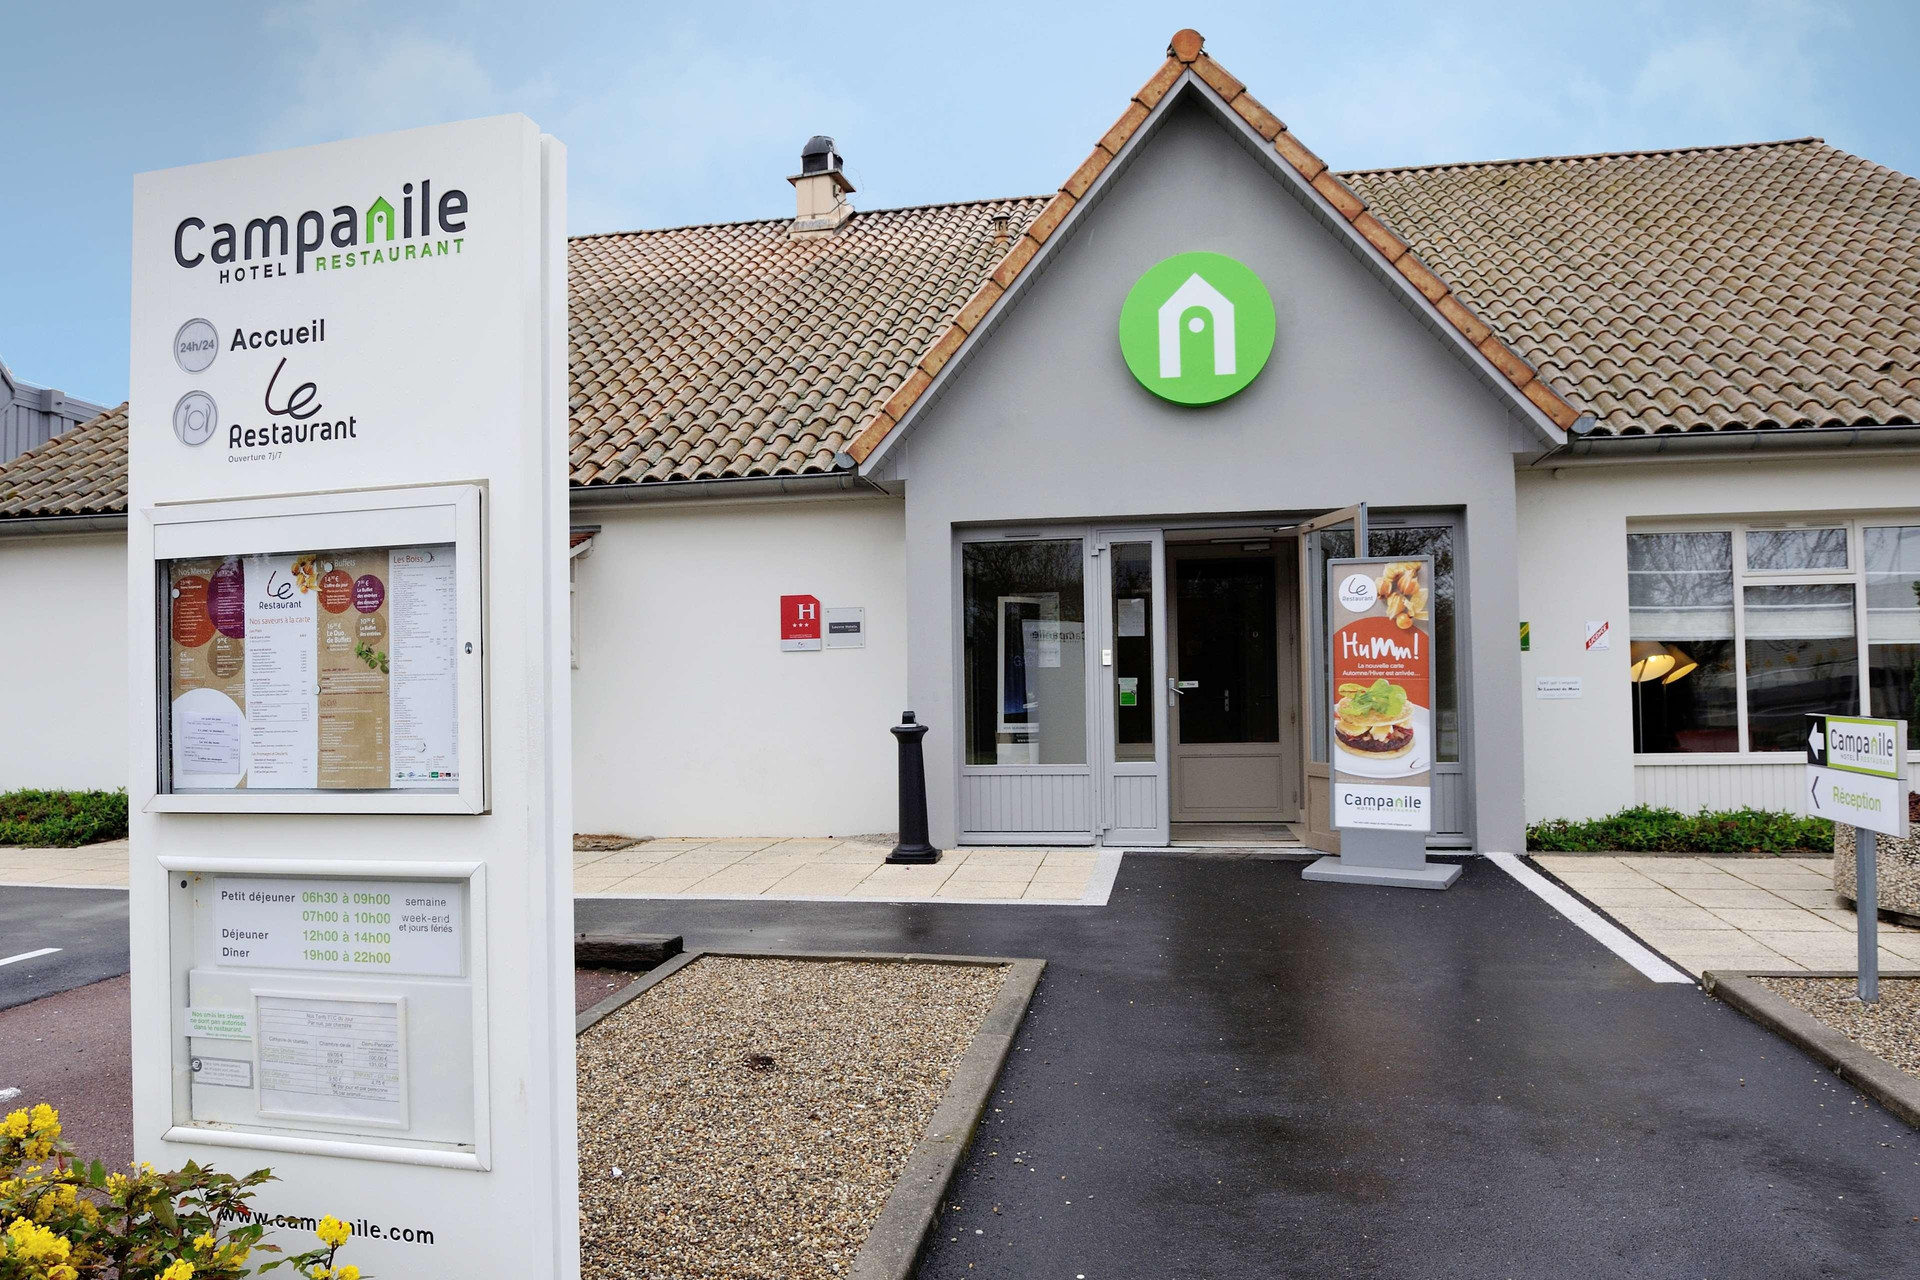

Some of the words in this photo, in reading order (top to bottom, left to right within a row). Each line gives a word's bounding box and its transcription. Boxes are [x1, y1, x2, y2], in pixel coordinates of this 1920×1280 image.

[174, 179, 469, 273] Campanile
[219, 262, 287, 284] HOTEL
[315, 238, 465, 272] RESTAURANT
[230, 319, 326, 352] Accueil
[180, 339, 215, 354] 24h/24
[265, 357, 323, 420] Le
[228, 416, 357, 449] Restaurant
[228, 452, 266, 463] Ouverture
[268, 451, 283, 463] 7j/7
[334, 559, 356, 567] Buffets
[406, 555, 435, 563] Boisss
[266, 571, 294, 600] Le
[1348, 577, 1368, 595] Le
[259, 600, 302, 610] Restaurant
[798, 603, 815, 620] H
[1831, 729, 1893, 761] Campanile
[1344, 793, 1422, 811] Campanile
[1832, 786, 1882, 812] Réception
[221, 890, 246, 902] Petit
[249, 891, 296, 903] déjeuner
[302, 892, 338, 905] 06h30
[343, 892, 349, 904] à
[353, 893, 391, 906] 09h00
[405, 897, 447, 908] semaine
[302, 911, 338, 923] 07h00
[343, 911, 349, 923] à
[354, 911, 391, 925] 10h00
[401, 912, 450, 924] week-end
[222, 928, 269, 941] Déjeuner
[303, 930, 338, 943] 12h00
[343, 931, 349, 943] à
[354, 931, 391, 944] 14h00
[399, 924, 407, 932] et
[408, 924, 429, 934] jours
[430, 924, 453, 934] fériés
[222, 946, 250, 958] Dîner
[303, 949, 339, 962] 19h00
[343, 950, 349, 962] à
[354, 951, 391, 964] 22h00
